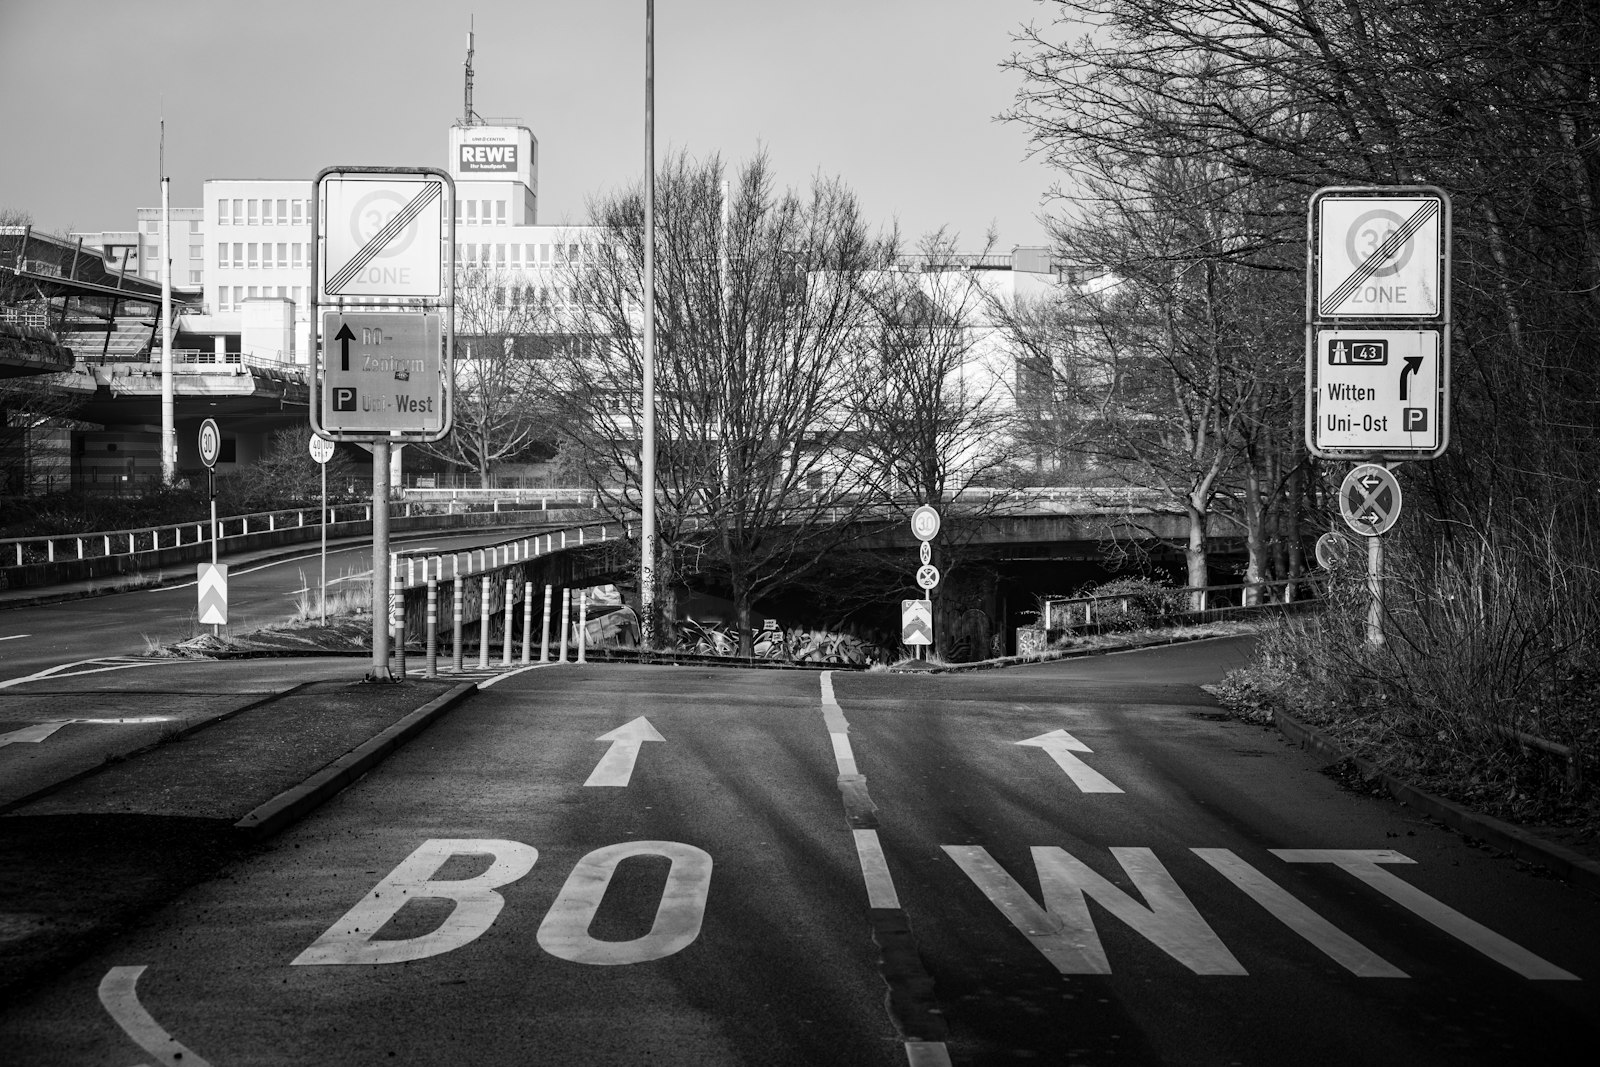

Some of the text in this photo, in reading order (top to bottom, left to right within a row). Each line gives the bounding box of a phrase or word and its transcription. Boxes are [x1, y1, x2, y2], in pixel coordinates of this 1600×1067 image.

[462, 146, 515, 162] REWE
[1361, 229, 1399, 259] 30
[356, 266, 411, 284] ZONE
[1352, 286, 1407, 303] ZONE
[1360, 347, 1376, 359] 43
[338, 389, 433, 413] P Uni-West
[1328, 383, 1375, 401] Witten
[1327, 409, 1424, 432] Uni-Ost P
[203, 433, 213, 453] 30
[918, 516, 934, 531] 30
[290, 838, 713, 966] BO
[940, 844, 1583, 980] WIT
